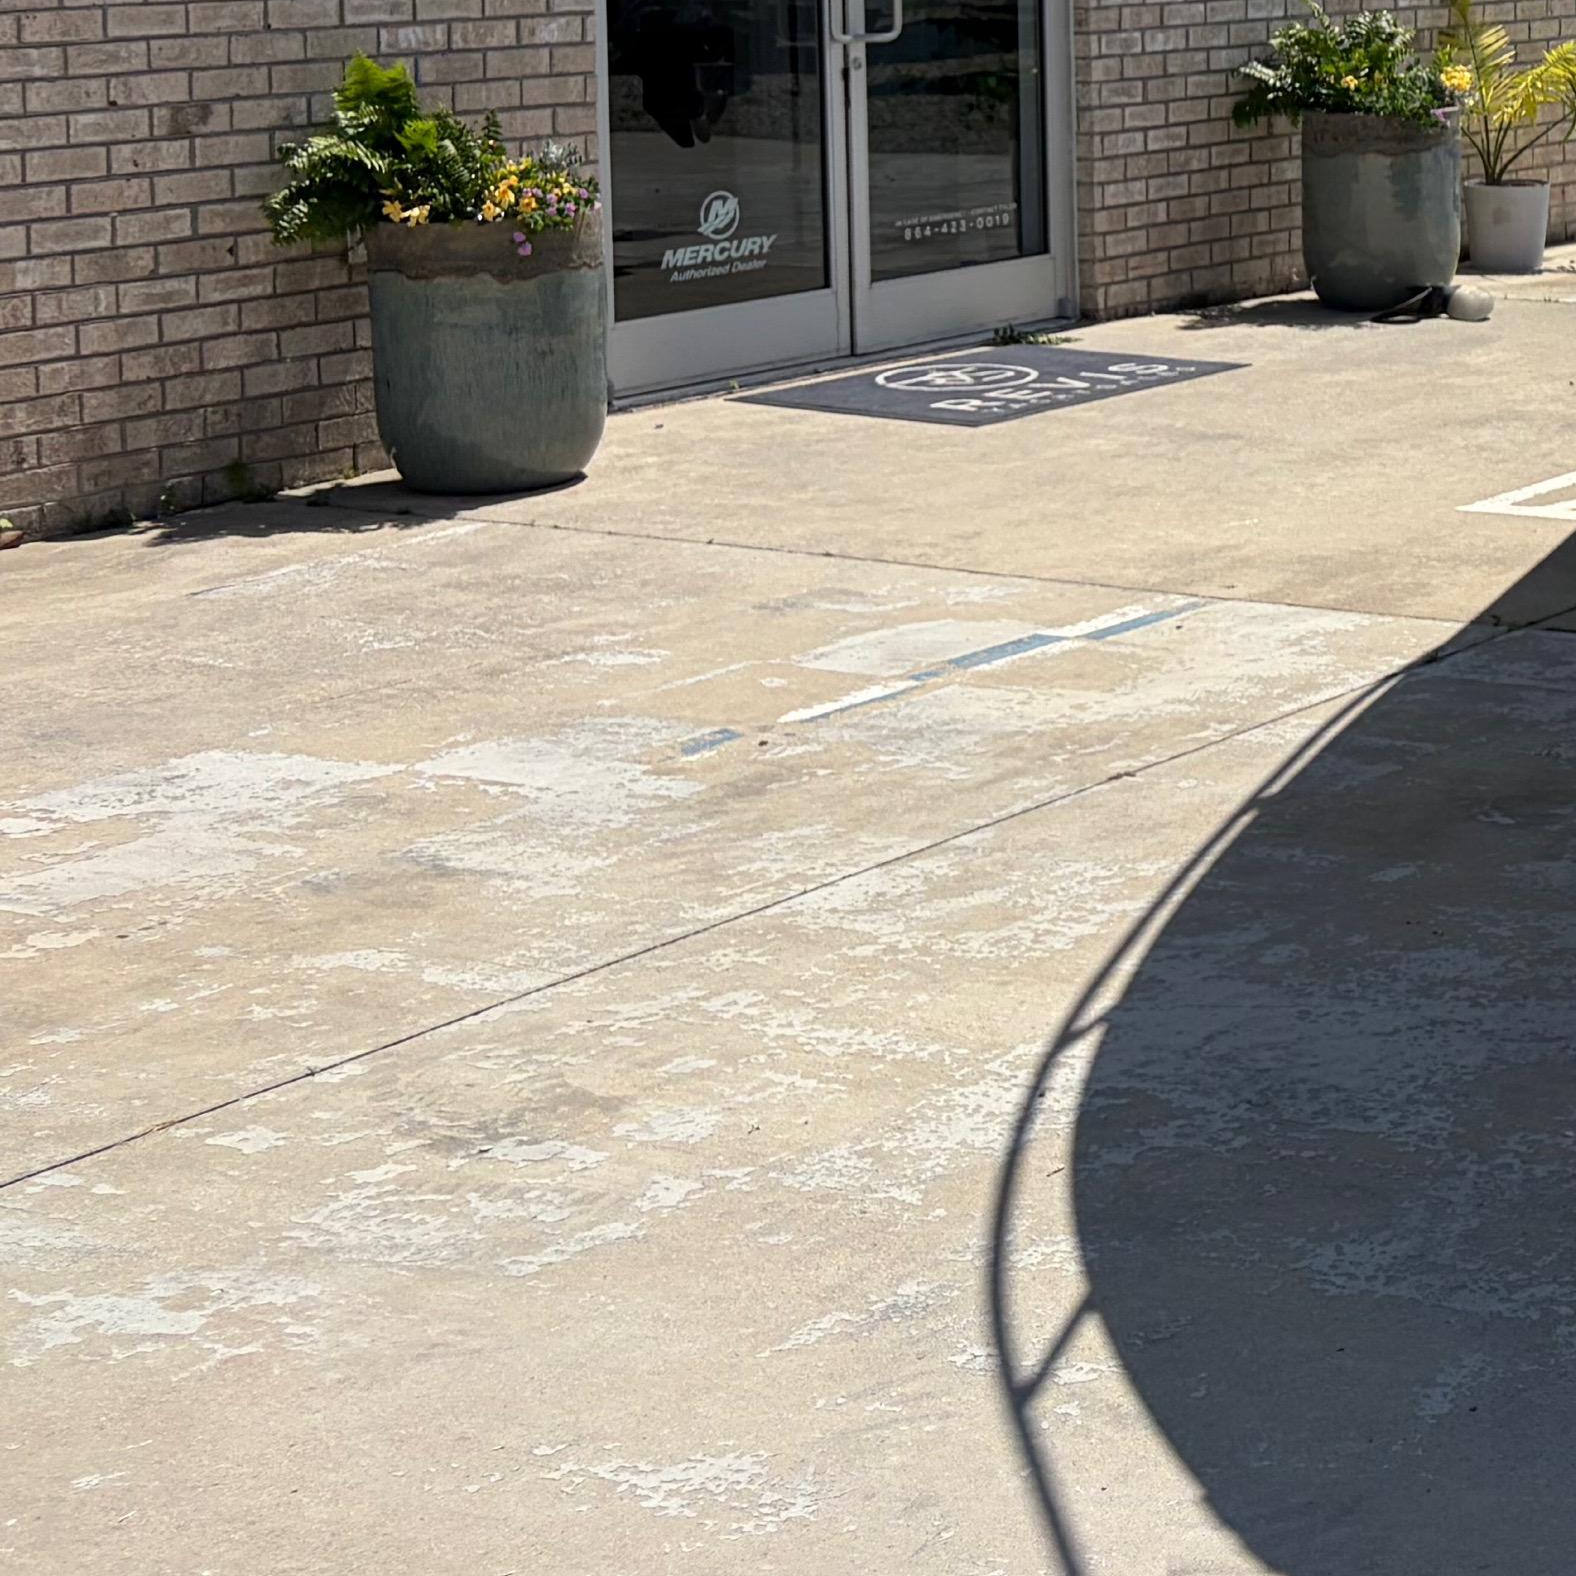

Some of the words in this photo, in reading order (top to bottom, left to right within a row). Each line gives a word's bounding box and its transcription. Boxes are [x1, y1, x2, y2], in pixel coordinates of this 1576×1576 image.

[661, 234, 778, 270] MERCURY
[670, 262, 731, 282] Authorized
[929, 362, 1169, 412] REVIS
